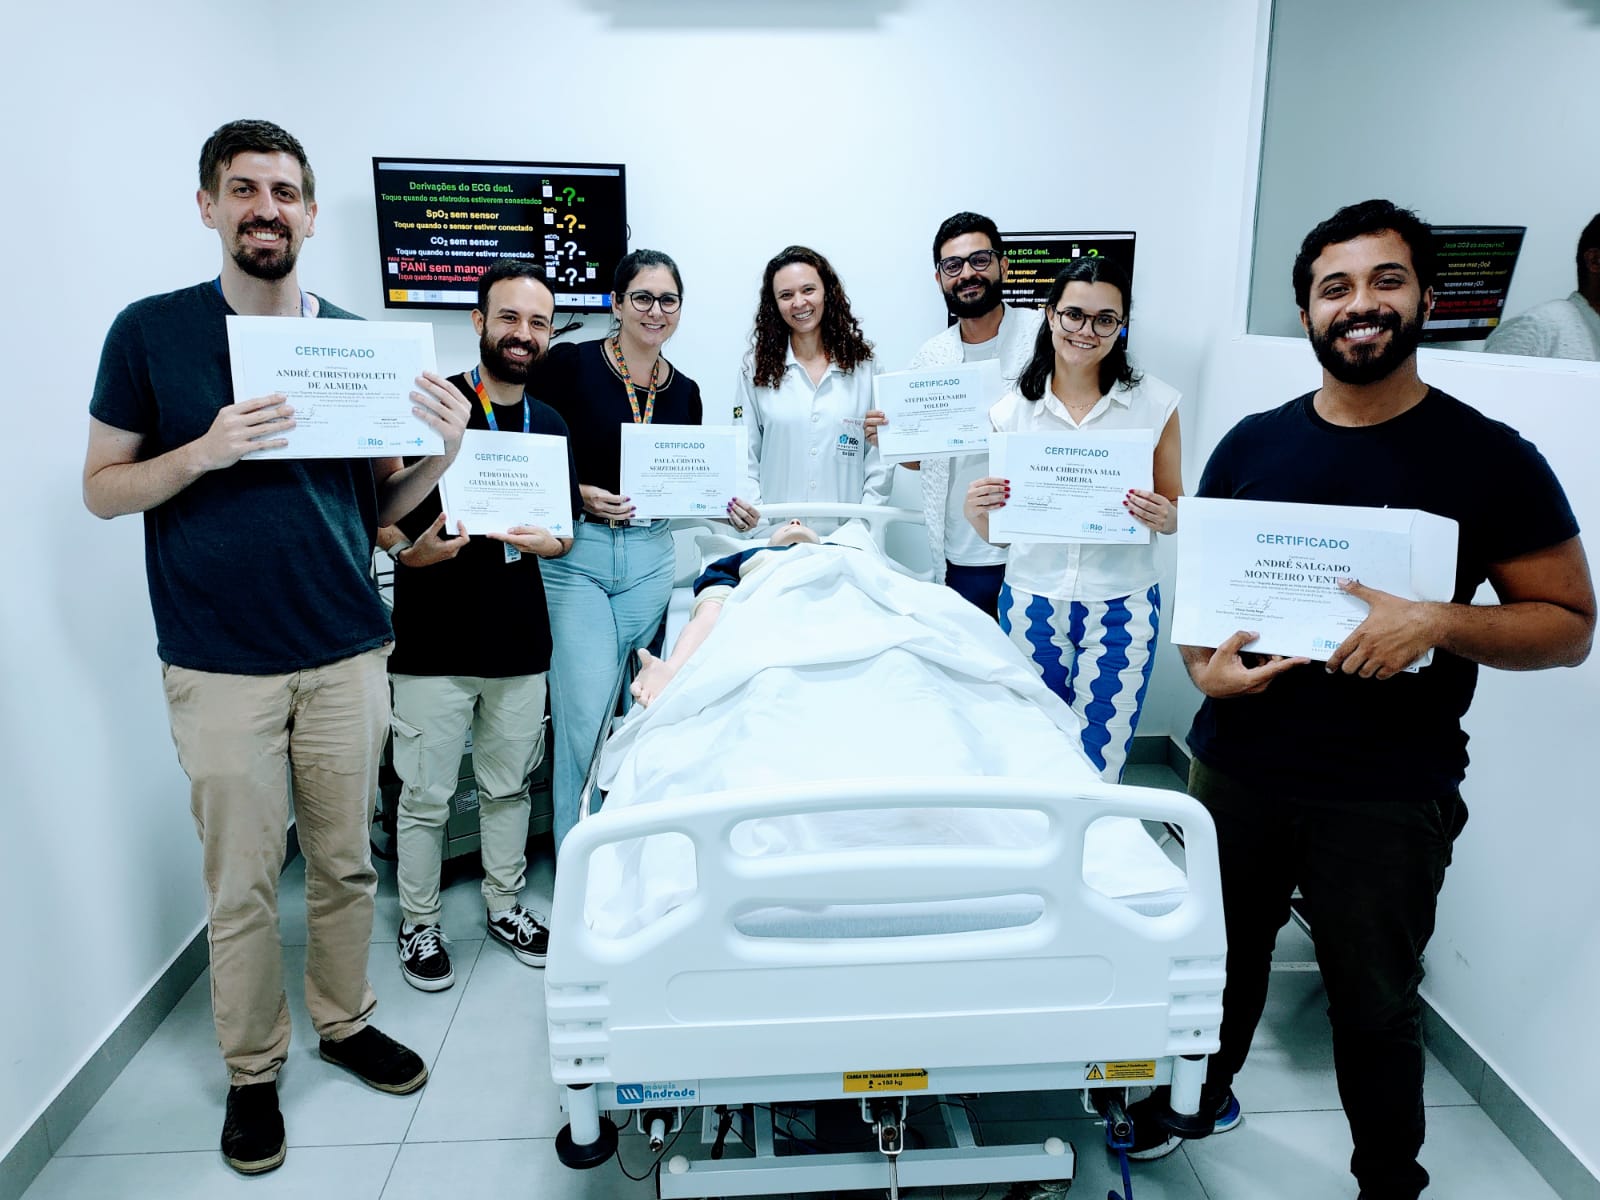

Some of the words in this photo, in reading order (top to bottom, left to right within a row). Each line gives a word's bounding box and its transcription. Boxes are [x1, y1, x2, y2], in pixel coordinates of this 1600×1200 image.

[410, 182, 456, 192] Derivações
[472, 184, 490, 192] ECG
[381, 194, 402, 202] Toque
[394, 221, 414, 230] Toque
[396, 248, 417, 256] Toque
[400, 262, 426, 272] PANI
[429, 264, 451, 272] sem
[454, 264, 492, 275] mangu
[295, 346, 375, 359] CERTIFICADO
[276, 368, 311, 378] ANDRÉ
[313, 370, 396, 380] CHRISTOFOLETTI
[324, 382, 368, 391] ALMEIDA
[909, 378, 960, 388] CERTIFICADO
[368, 438, 383, 446] Rio
[1045, 446, 1109, 458] CERTIFICADO
[475, 453, 528, 463] CERTIFICADO
[1030, 464, 1054, 473] NÁDIA
[1056, 467, 1098, 475] CHRISTINA
[1056, 476, 1092, 484] MOREIRA
[1256, 534, 1350, 550] CERTIFICADO
[1255, 558, 1293, 569] ANDRÉ
[1296, 562, 1351, 573] SALGADO
[1244, 570, 1304, 582] MONTEIRO
[645, 1088, 696, 1099] Andrade
